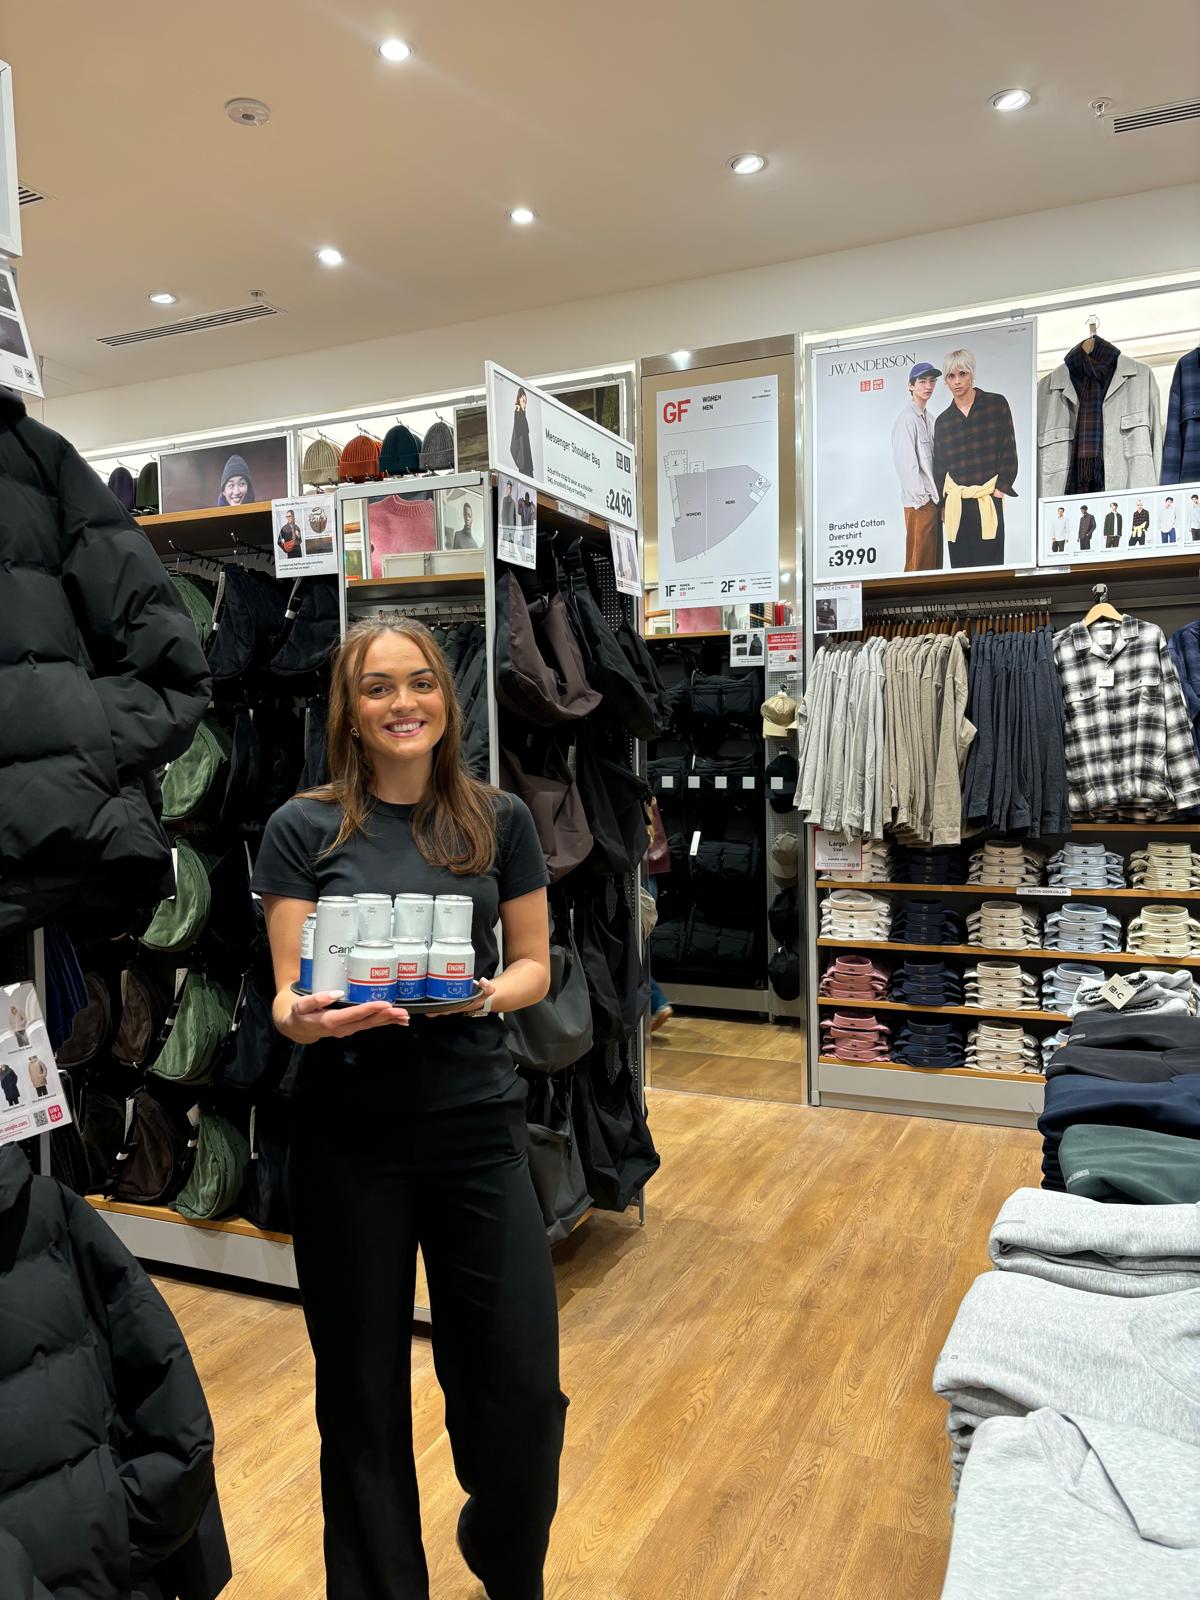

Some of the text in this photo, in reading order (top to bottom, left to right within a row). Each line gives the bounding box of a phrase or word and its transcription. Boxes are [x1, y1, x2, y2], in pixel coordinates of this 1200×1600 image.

[702, 394, 721, 403] WOMEN
[663, 399, 691, 424] GF
[545, 429, 571, 451] Messenger
[571, 442, 591, 461] Shoulder
[592, 453, 601, 469] Bag
[606, 489, 632, 518] £24.90
[829, 519, 885, 531] Brushed Cotton
[829, 531, 862, 541] Overshirt
[829, 547, 877, 567] £39.90
[665, 585, 676, 597] 1F
[721, 580, 736, 593] 2F
[372, 969, 390, 977] ENGINE
[447, 964, 465, 972] ENGINE
[49, 1105, 60, 1114] UNI
[50, 1111, 62, 1120] QLO
